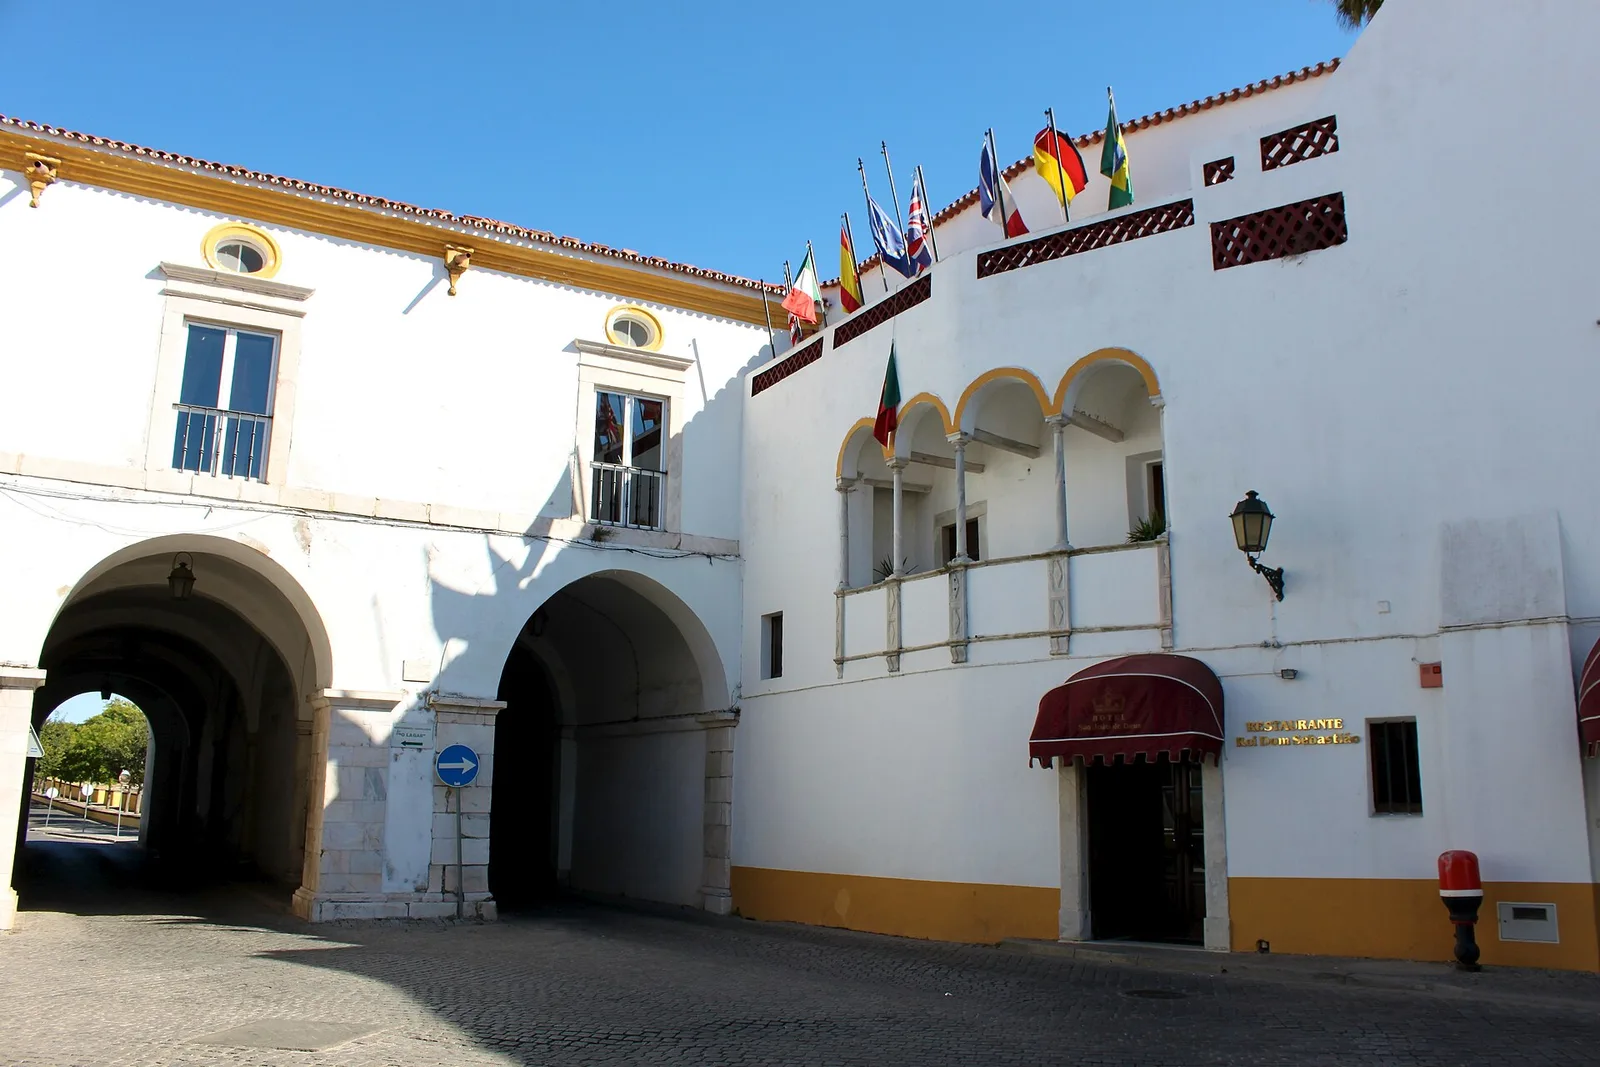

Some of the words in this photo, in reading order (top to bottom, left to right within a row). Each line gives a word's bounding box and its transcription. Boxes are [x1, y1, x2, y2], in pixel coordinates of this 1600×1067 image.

[1246, 718, 1344, 732] RESTAURANTE
[1259, 735, 1291, 746] Dom
[1292, 733, 1361, 745] Sebastião
